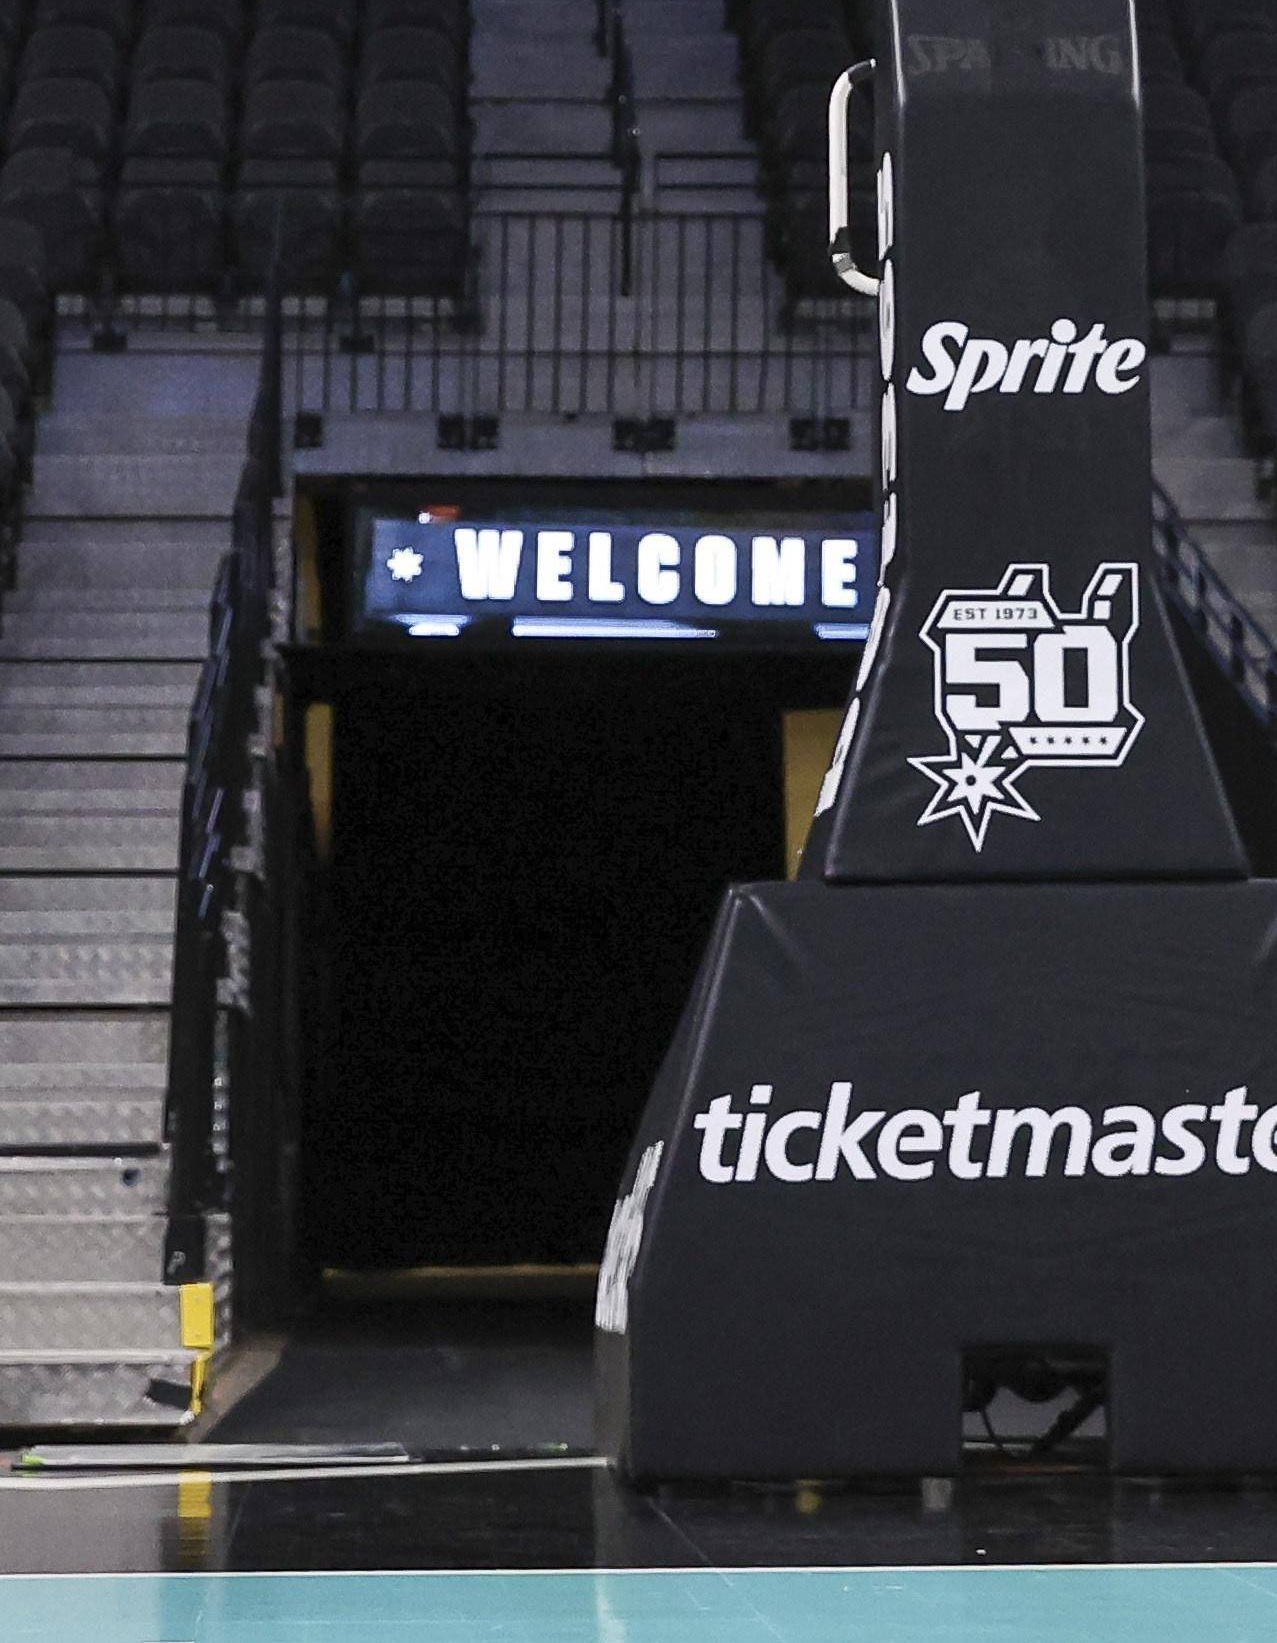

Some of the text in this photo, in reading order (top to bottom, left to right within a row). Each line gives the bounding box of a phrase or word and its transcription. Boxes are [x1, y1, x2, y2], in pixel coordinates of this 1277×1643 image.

[905, 318, 1146, 411] Sprite
[454, 528, 859, 608] WELCOME
[953, 607, 1038, 622] EST 1973
[945, 625, 1118, 731] 50
